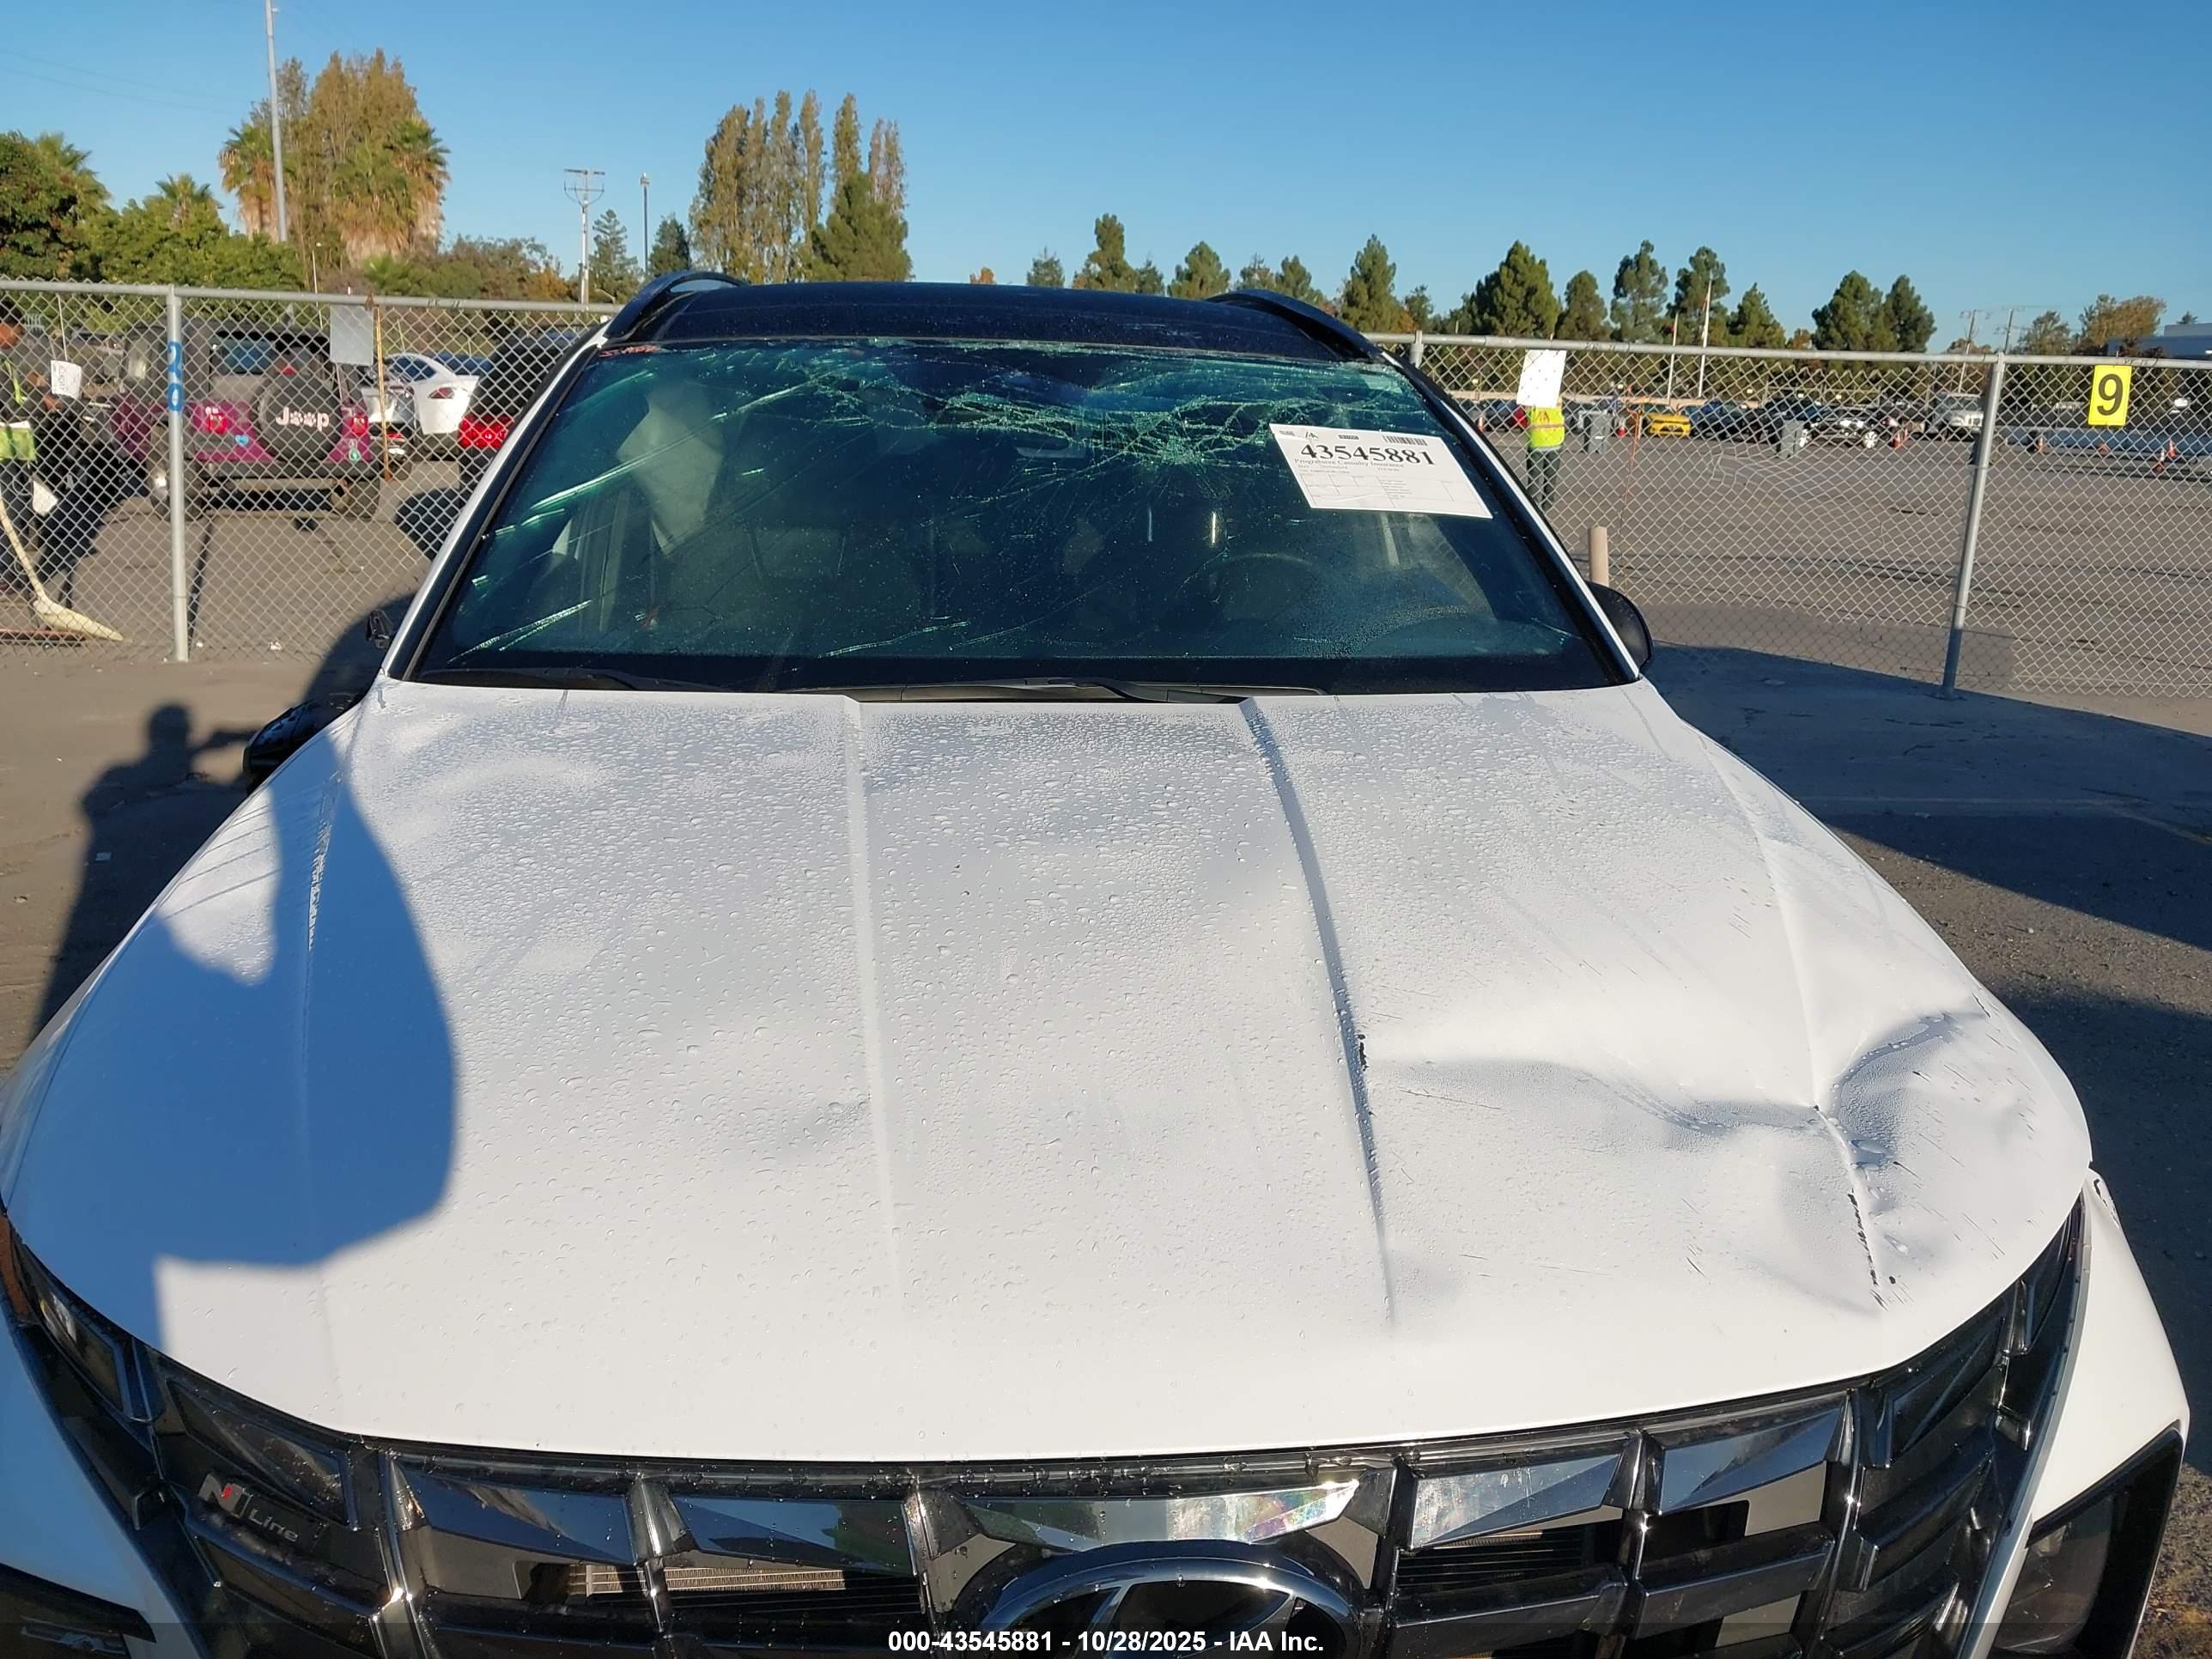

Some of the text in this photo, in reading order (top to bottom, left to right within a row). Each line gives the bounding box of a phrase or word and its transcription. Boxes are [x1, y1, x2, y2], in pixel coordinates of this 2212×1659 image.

[2097, 374, 2123, 416] 9
[1301, 444, 1435, 465] 43545881
[248, 1509, 298, 1542] Line
